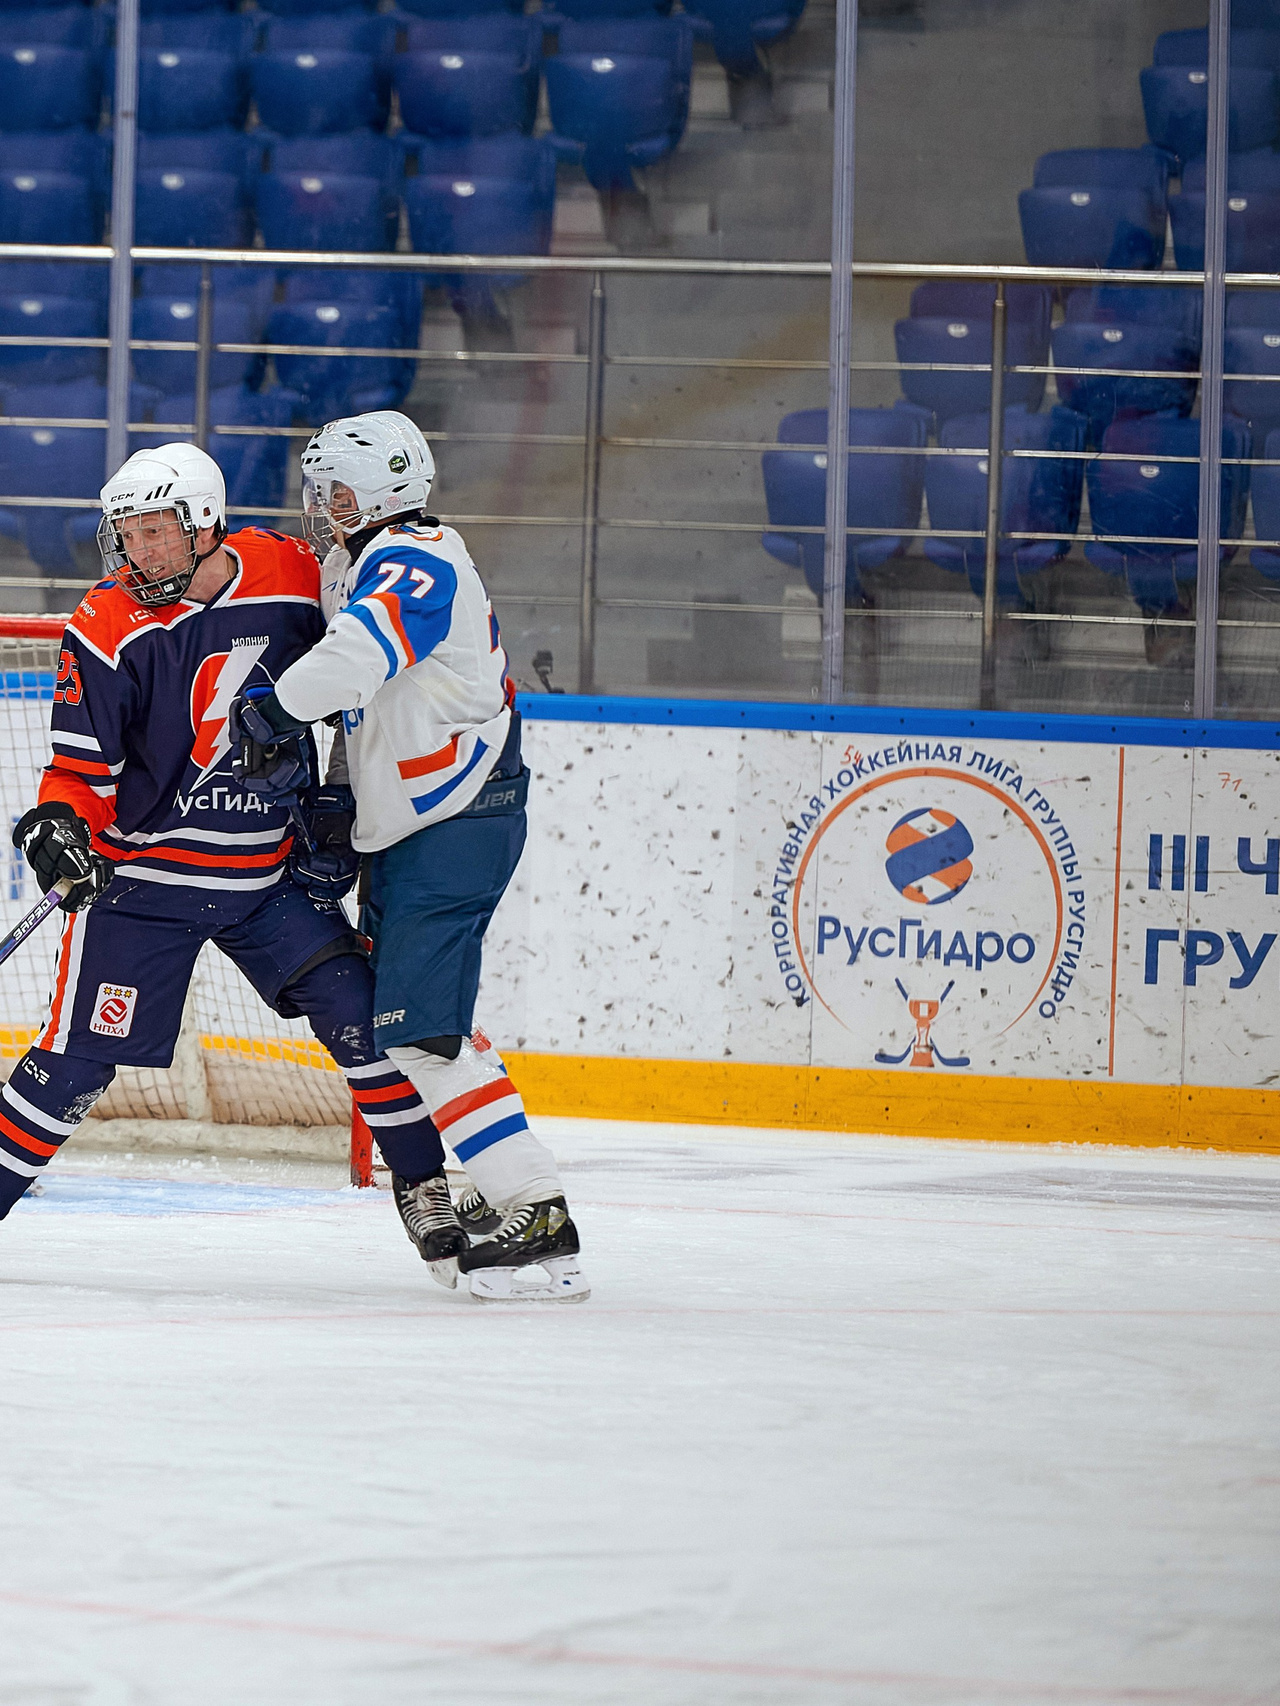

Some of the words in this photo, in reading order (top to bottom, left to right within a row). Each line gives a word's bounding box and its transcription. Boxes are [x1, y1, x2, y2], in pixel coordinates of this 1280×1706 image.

[110, 491, 135, 503] CCM
[372, 562, 435, 600] 77
[231, 635, 270, 648] МОЛНИЯ
[823, 742, 962, 800] ХОККЕЙНАЯ
[966, 750, 1024, 793] ЛИГА
[173, 786, 276, 818] усГид
[1024, 787, 1082, 883] ГРУППЫ
[771, 795, 826, 1007] КОРПОРАТИВНАЯ
[816, 915, 1036, 971] РусГидро
[1038, 889, 1086, 1019] РУСГИДРО
[1144, 928, 1278, 989] ГРУ
[93, 1022, 125, 1036] НПХЛ
